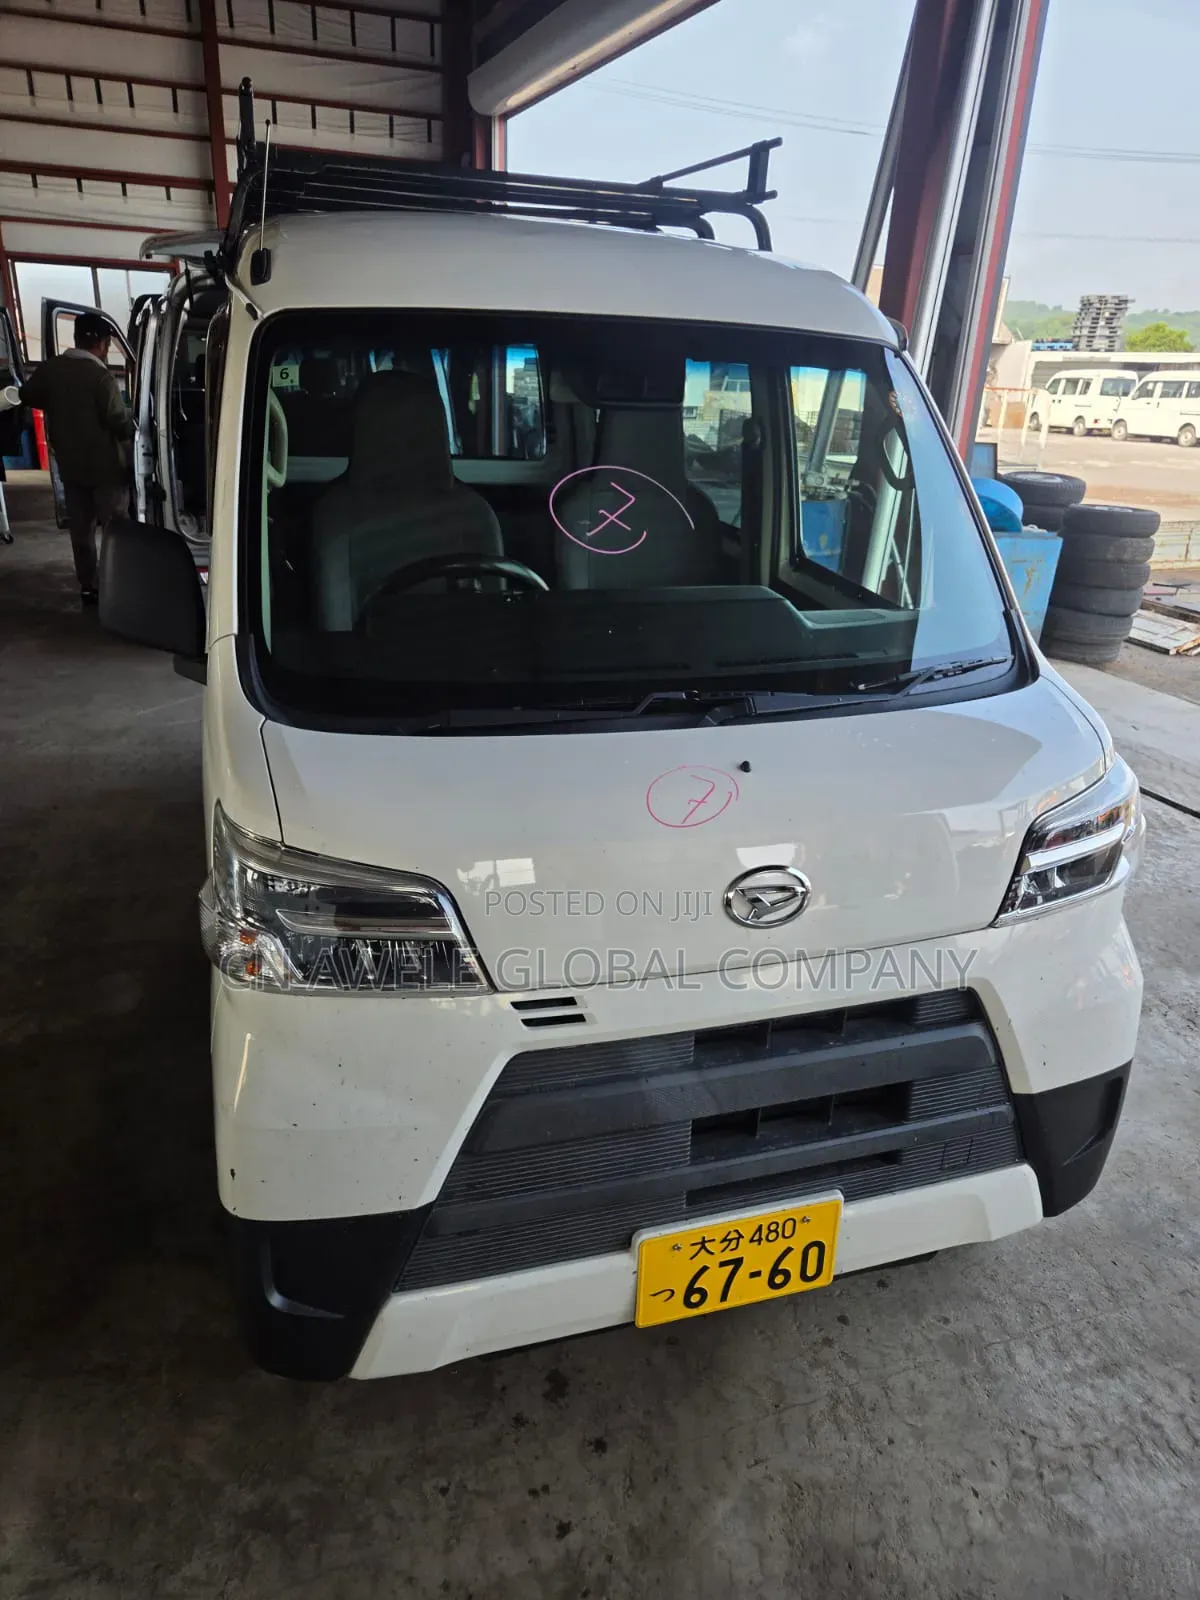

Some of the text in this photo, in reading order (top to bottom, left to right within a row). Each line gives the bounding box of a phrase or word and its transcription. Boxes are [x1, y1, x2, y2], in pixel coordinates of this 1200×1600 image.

[280, 367, 290, 380] 6
[682, 774, 715, 824] 7
[689, 1217, 796, 1260] 大分 480
[683, 1240, 826, 1309] 67-60
